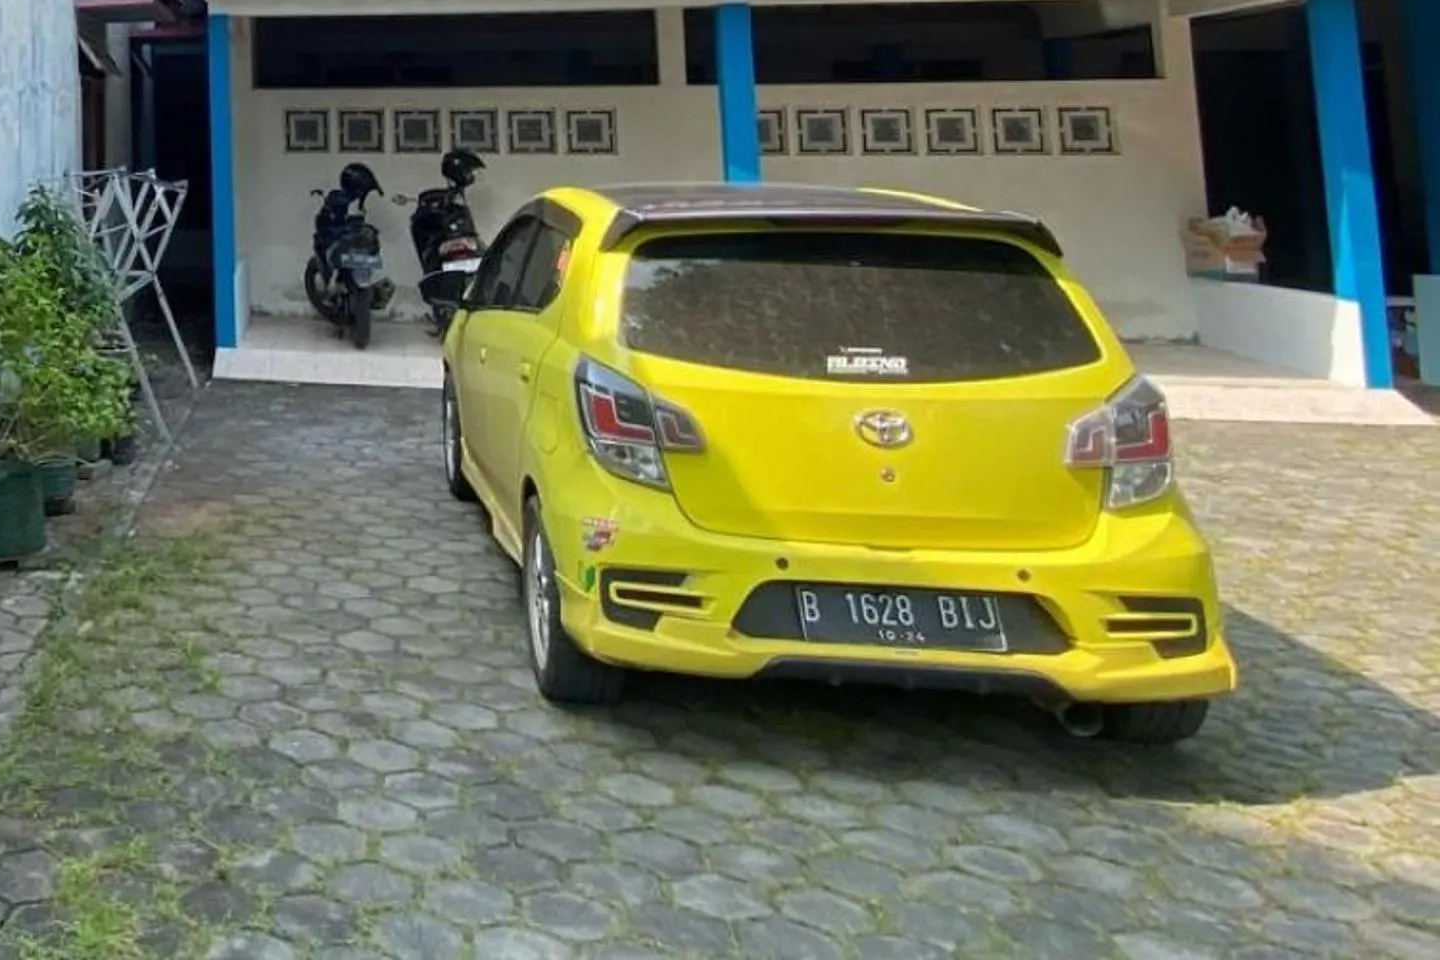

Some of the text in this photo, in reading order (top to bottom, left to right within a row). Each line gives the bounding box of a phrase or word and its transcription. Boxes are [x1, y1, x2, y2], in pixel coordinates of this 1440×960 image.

[802, 591, 996, 629] B 1628 BIJ
